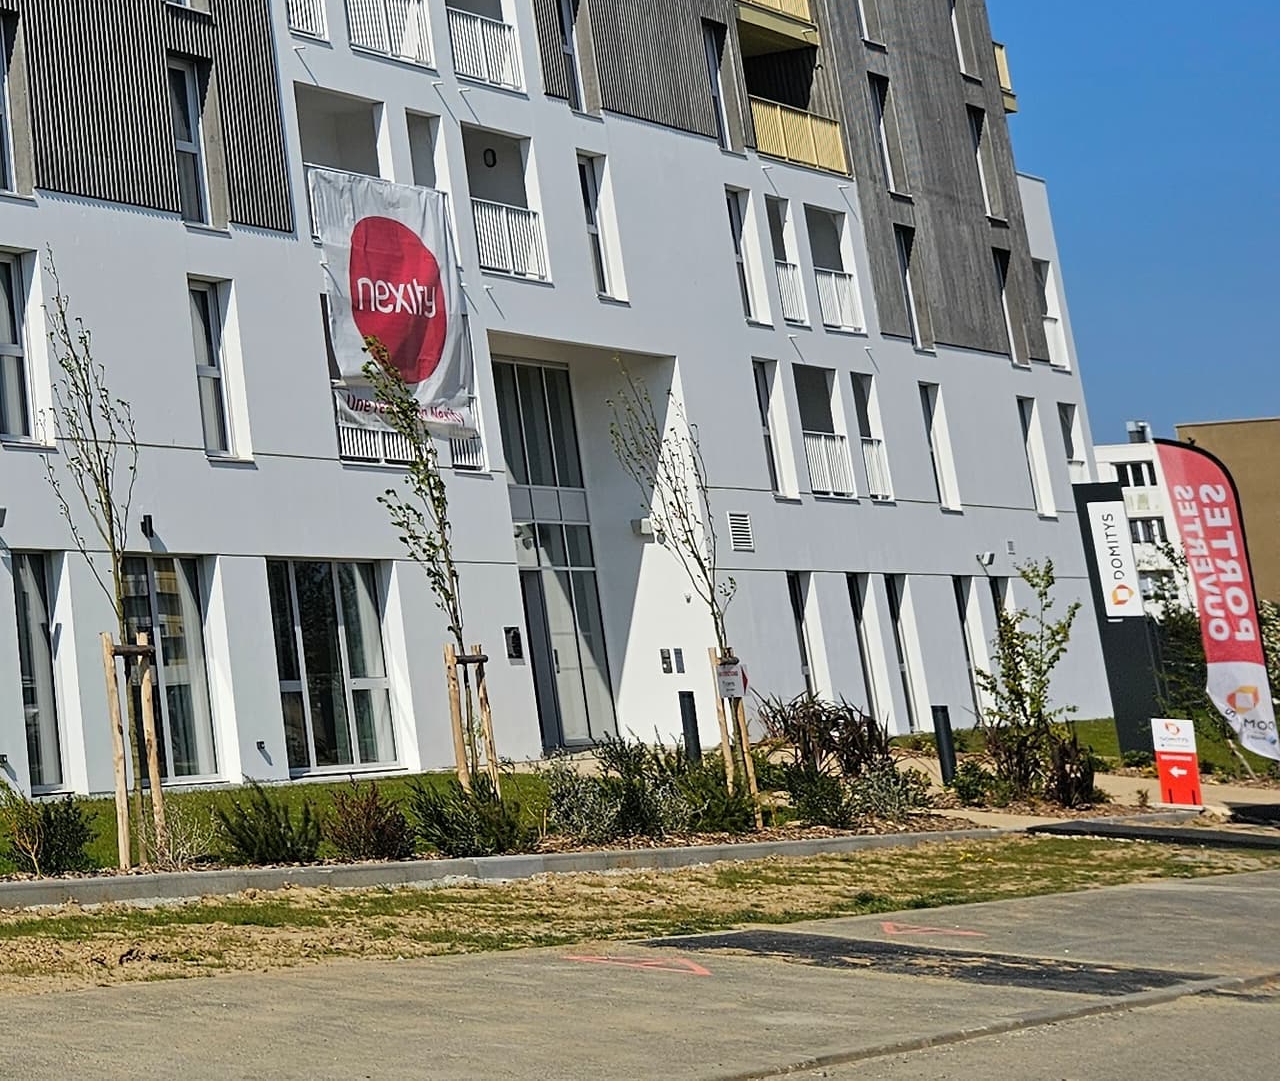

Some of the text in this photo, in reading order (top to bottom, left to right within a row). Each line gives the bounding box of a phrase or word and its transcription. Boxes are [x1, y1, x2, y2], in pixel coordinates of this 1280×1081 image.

[357, 277, 436, 318] nexity
[347, 394, 372, 413] Une
[1101, 513, 1125, 580] DOMITYS
